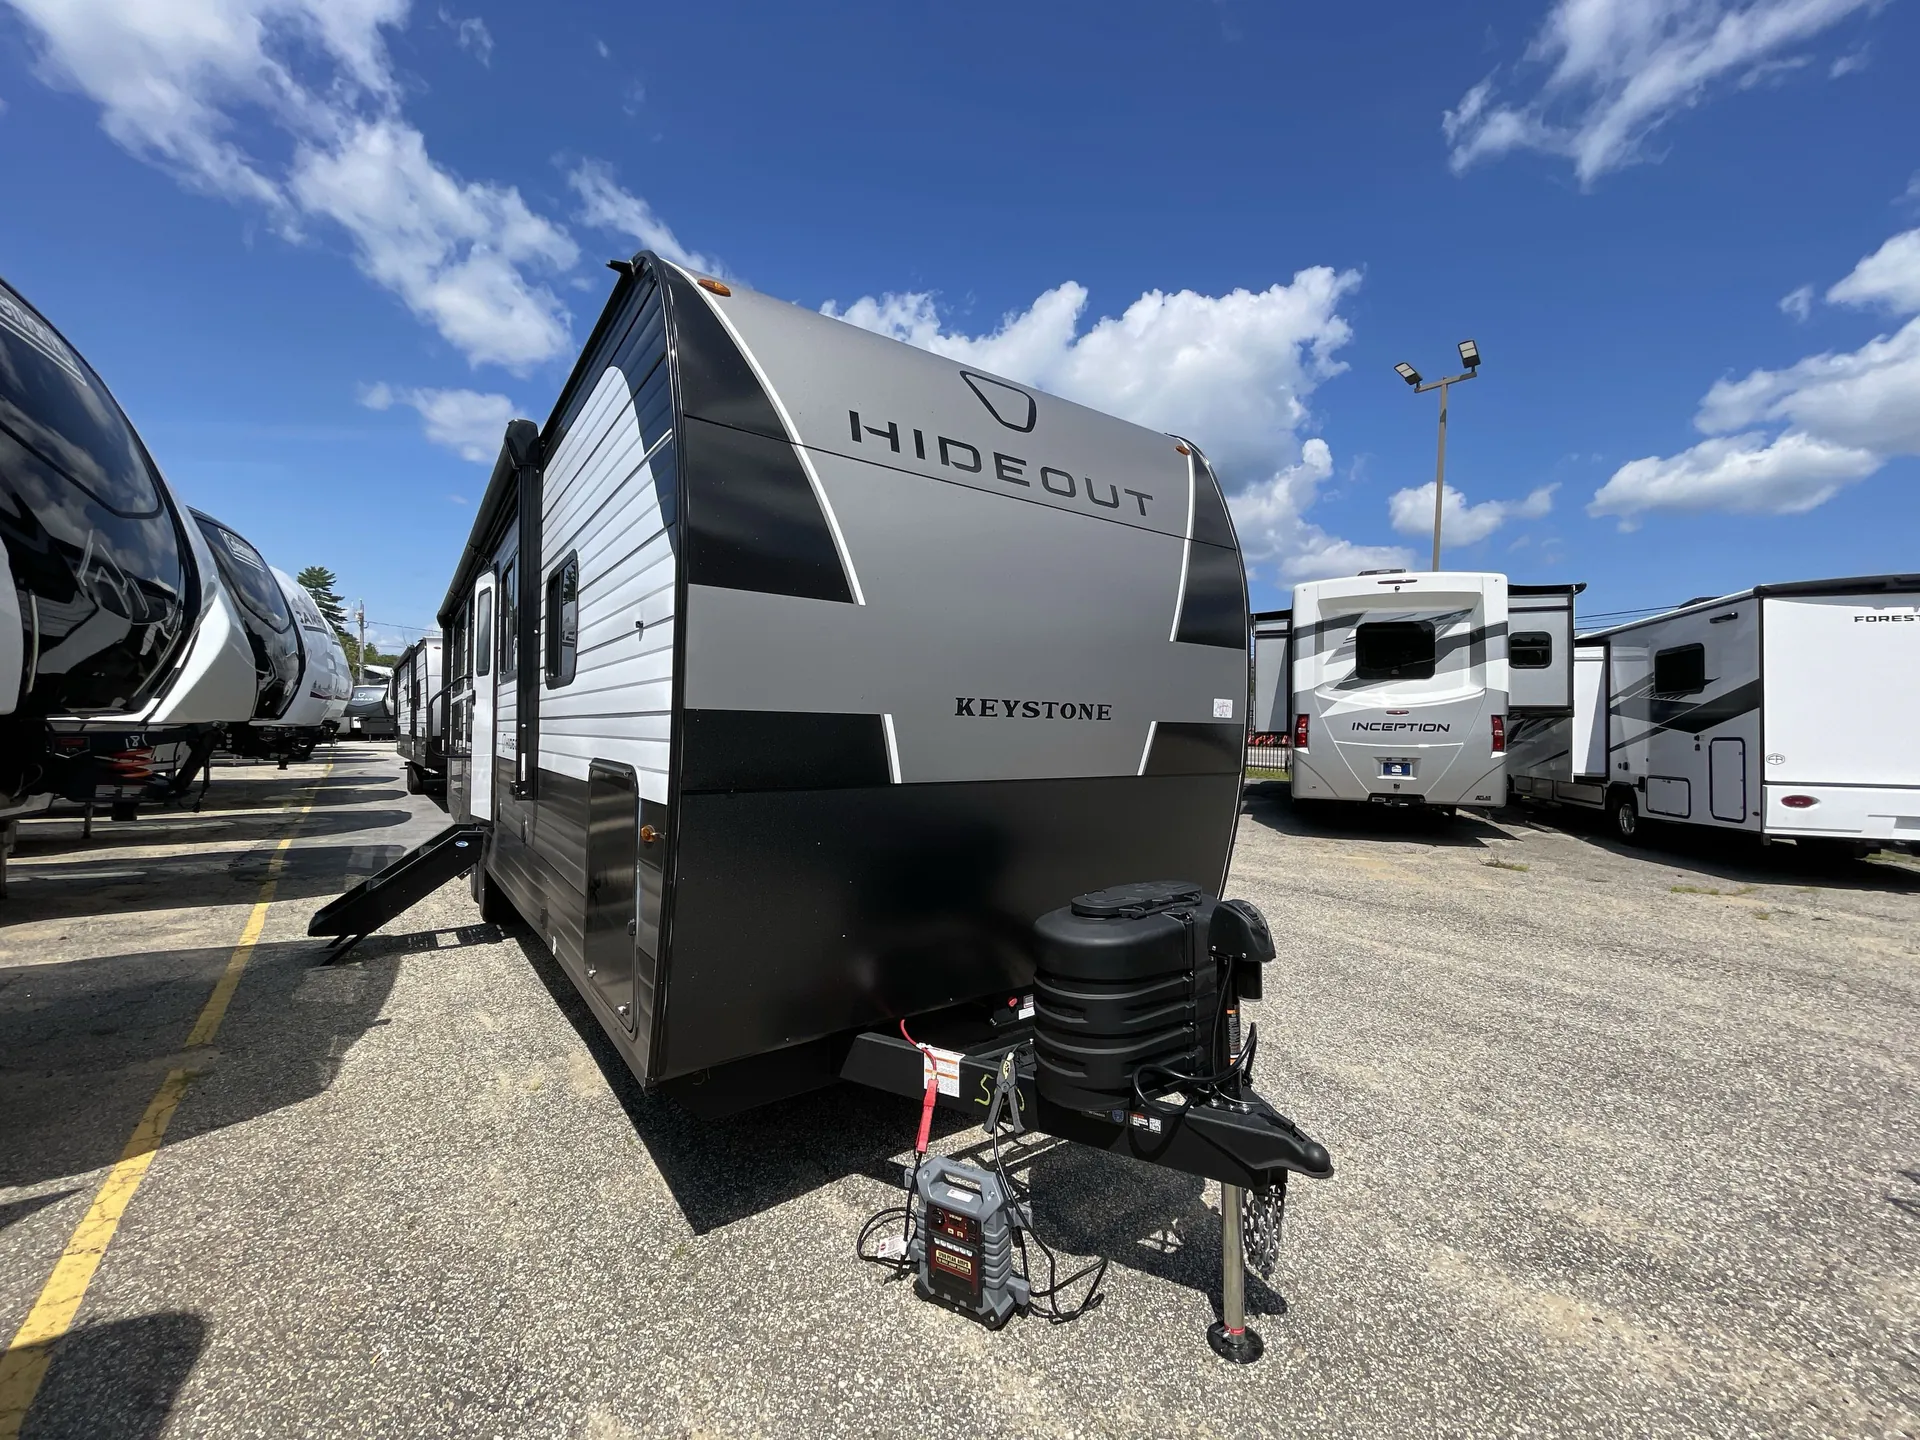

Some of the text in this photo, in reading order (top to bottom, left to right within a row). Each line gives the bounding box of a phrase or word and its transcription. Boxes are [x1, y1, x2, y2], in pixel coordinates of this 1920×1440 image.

[848, 409, 1154, 517] HIDEOUT
[954, 697, 1112, 721] KEYSTONE
[1351, 721, 1451, 733] INCEPTION
